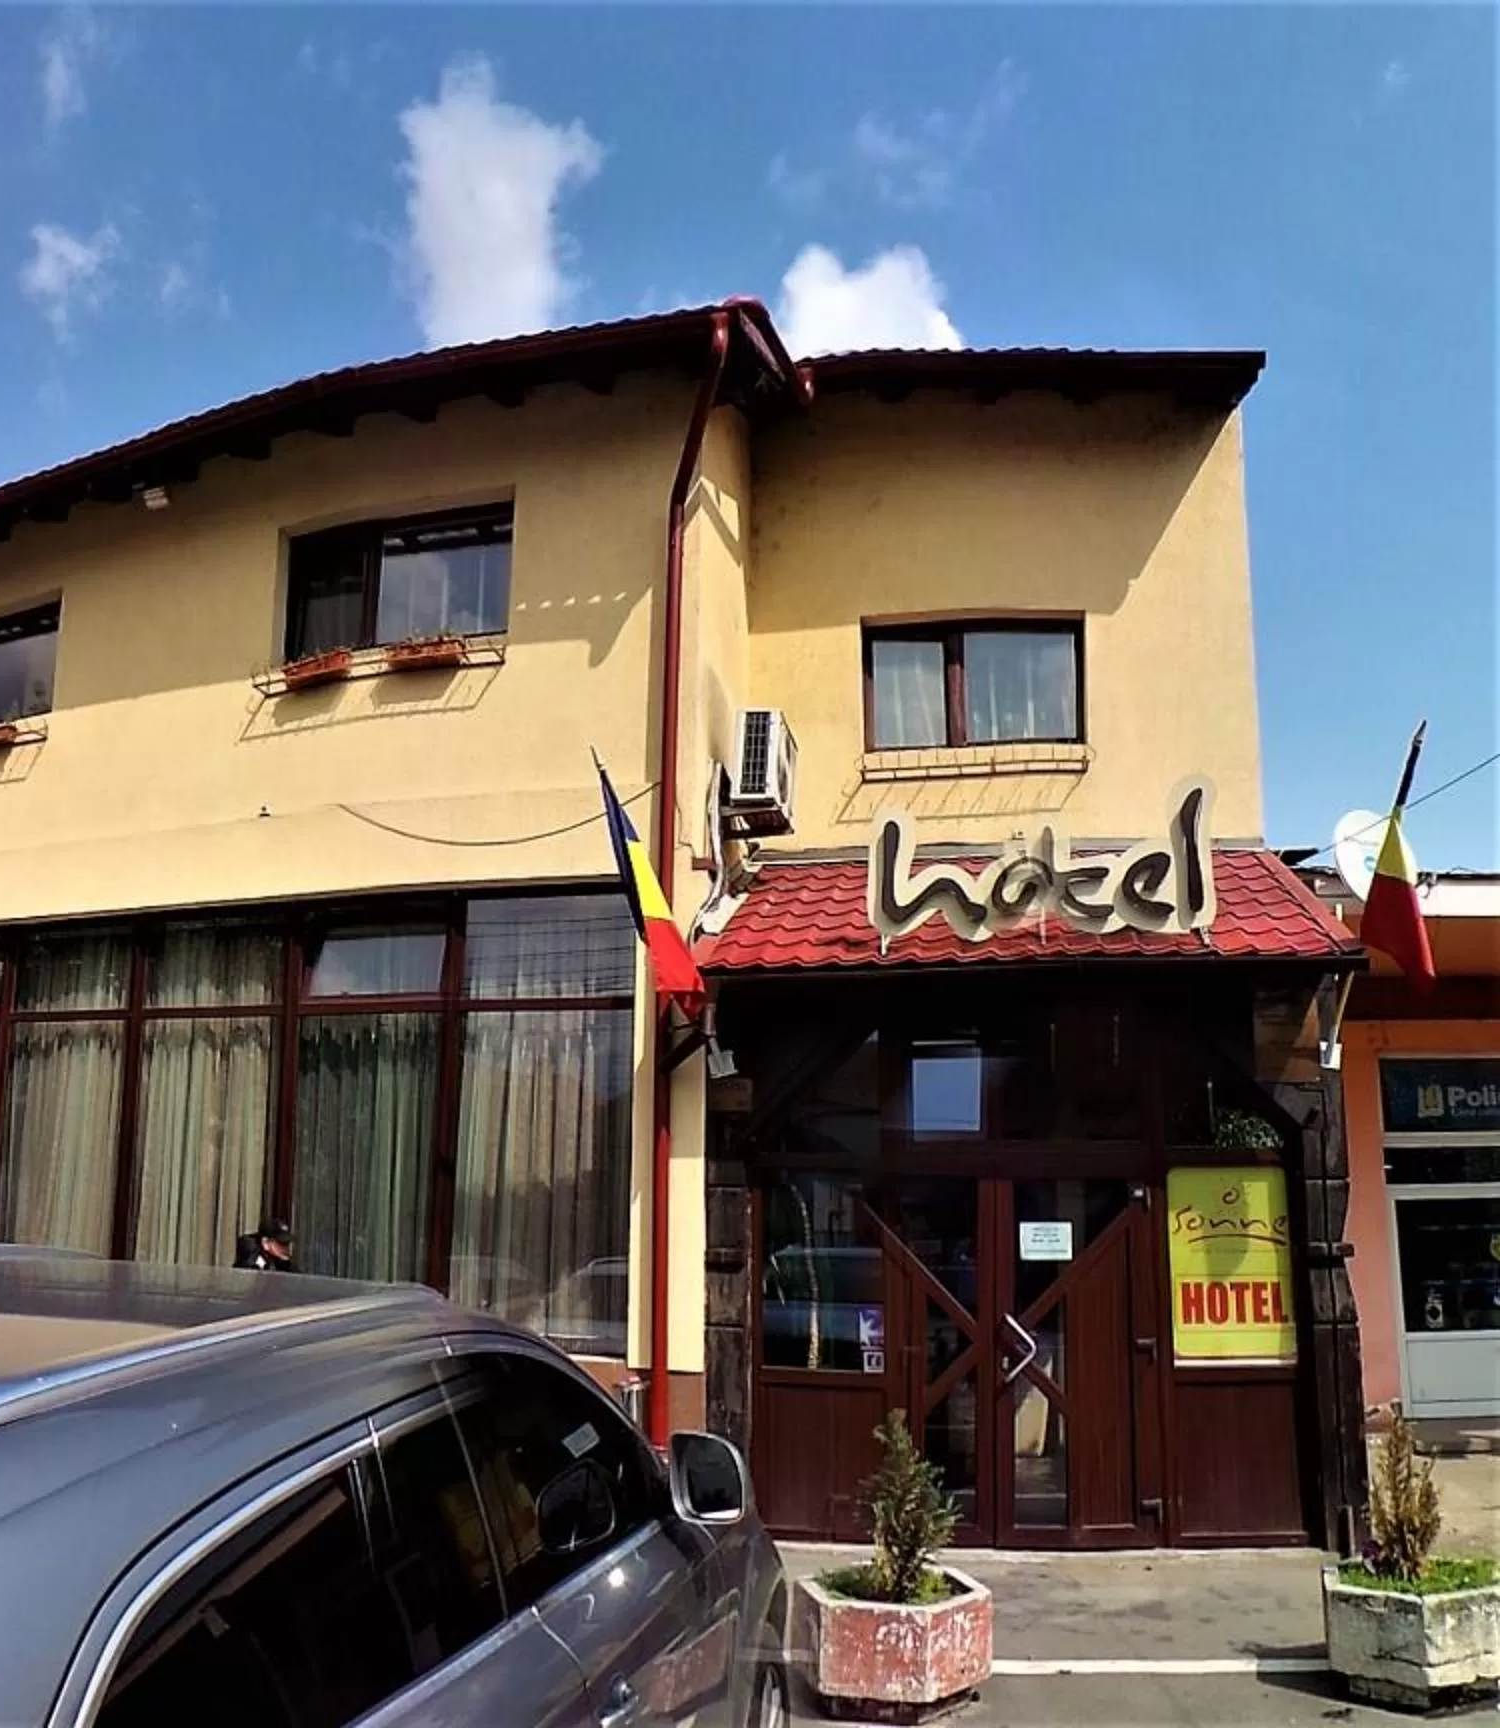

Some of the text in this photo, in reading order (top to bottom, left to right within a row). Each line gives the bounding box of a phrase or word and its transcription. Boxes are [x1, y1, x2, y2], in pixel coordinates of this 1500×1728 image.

[874, 782, 1208, 932] hotel
[1447, 1084, 1500, 1107] Poli
[1181, 1281, 1289, 1325] HOTEL
